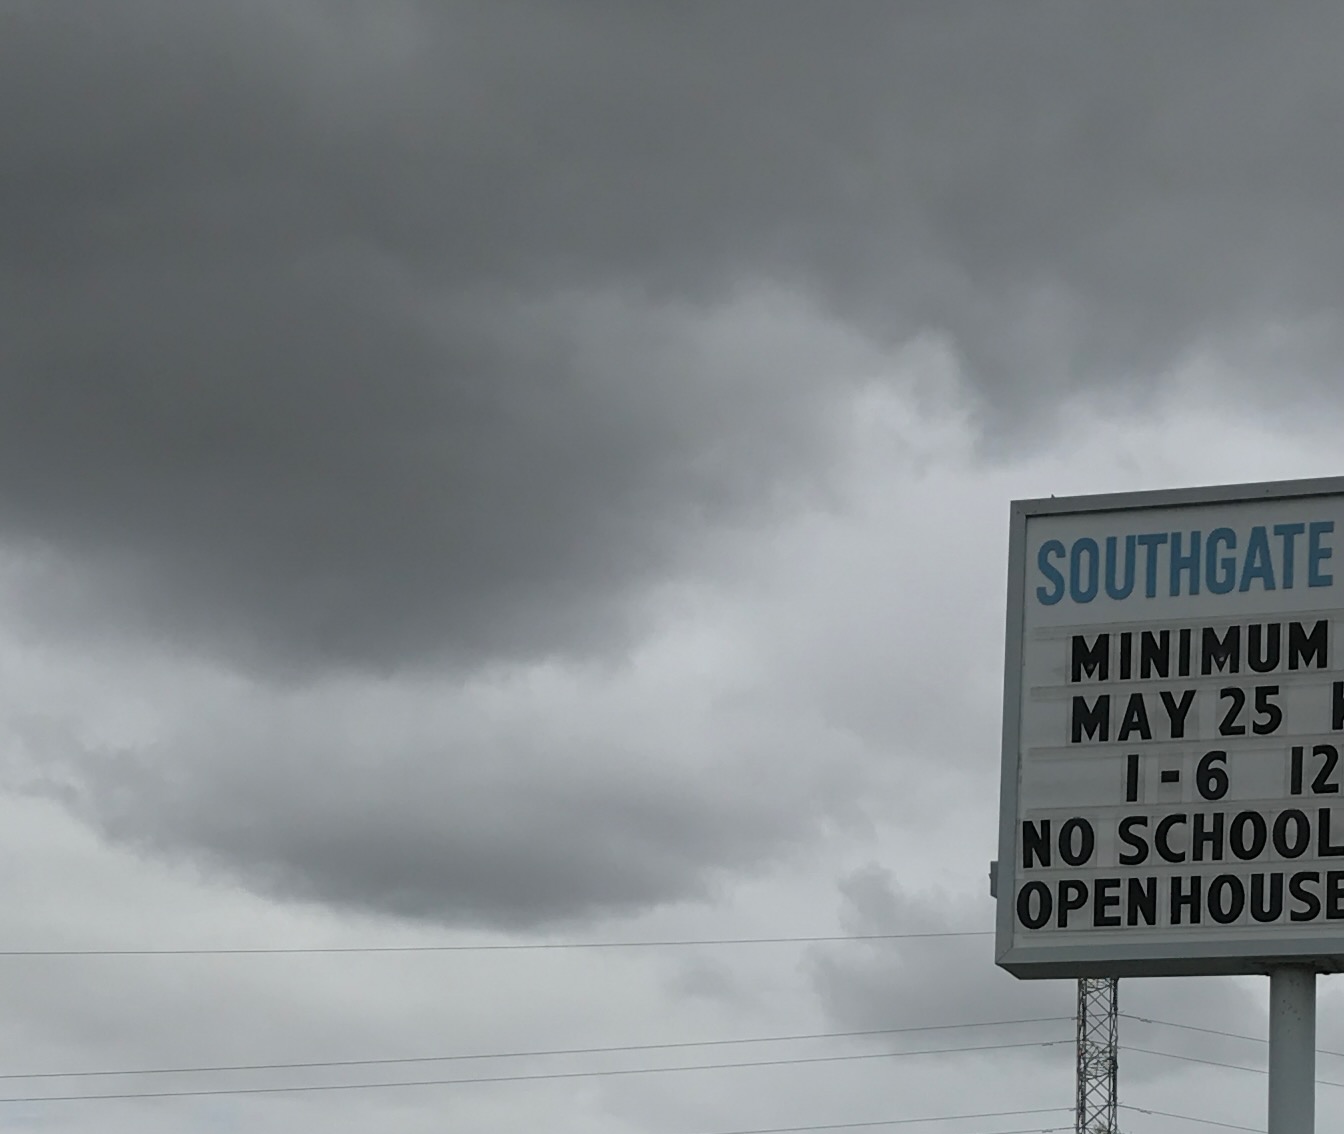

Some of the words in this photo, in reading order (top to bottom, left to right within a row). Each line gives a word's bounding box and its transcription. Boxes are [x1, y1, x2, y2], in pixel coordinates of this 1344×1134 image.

[1036, 521, 1334, 606] SOUTHGATE
[1071, 619, 1329, 683] MINIMUM
[1071, 689, 1197, 743] MAY
[1218, 685, 1283, 736] 25
[1022, 817, 1095, 869] NO
[1016, 876, 1157, 930] OPEN
